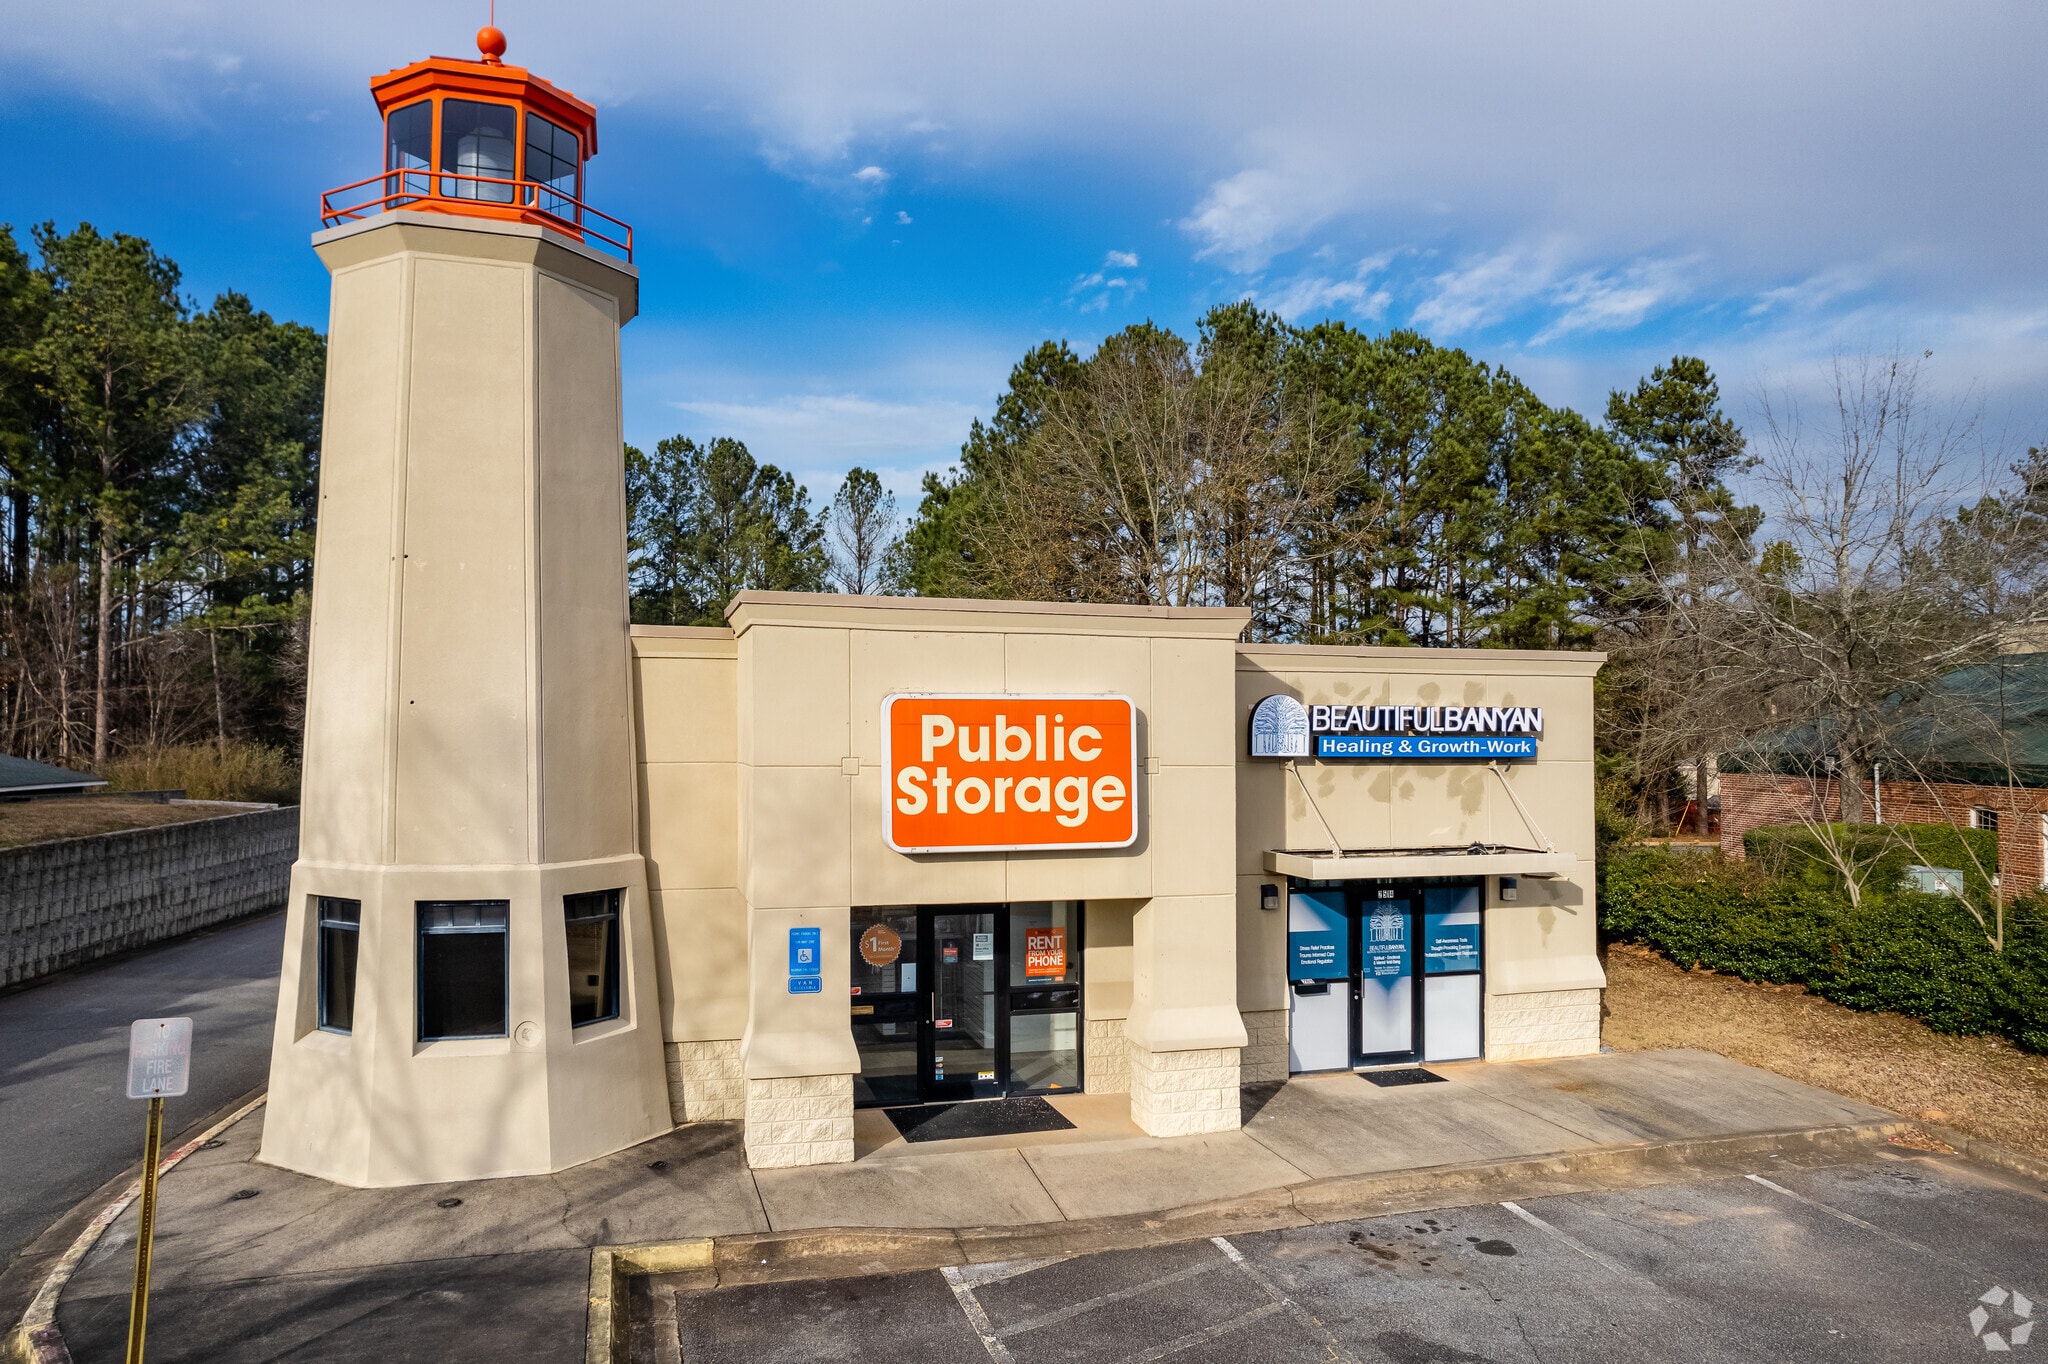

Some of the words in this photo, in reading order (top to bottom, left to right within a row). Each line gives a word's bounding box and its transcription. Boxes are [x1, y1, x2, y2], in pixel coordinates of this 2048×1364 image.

[1311, 705, 1543, 732] BEAUTIFULBANYAN
[921, 714, 1103, 762] Public
[1322, 739, 1393, 755] Healing
[1398, 740, 1413, 753] &
[1417, 739, 1531, 754] Growth-Work
[896, 766, 1126, 827] Storage
[1028, 935, 1063, 950] RENT
[1028, 955, 1063, 967] PHONE
[146, 1058, 173, 1075] FIRE
[142, 1076, 175, 1093] LANE
